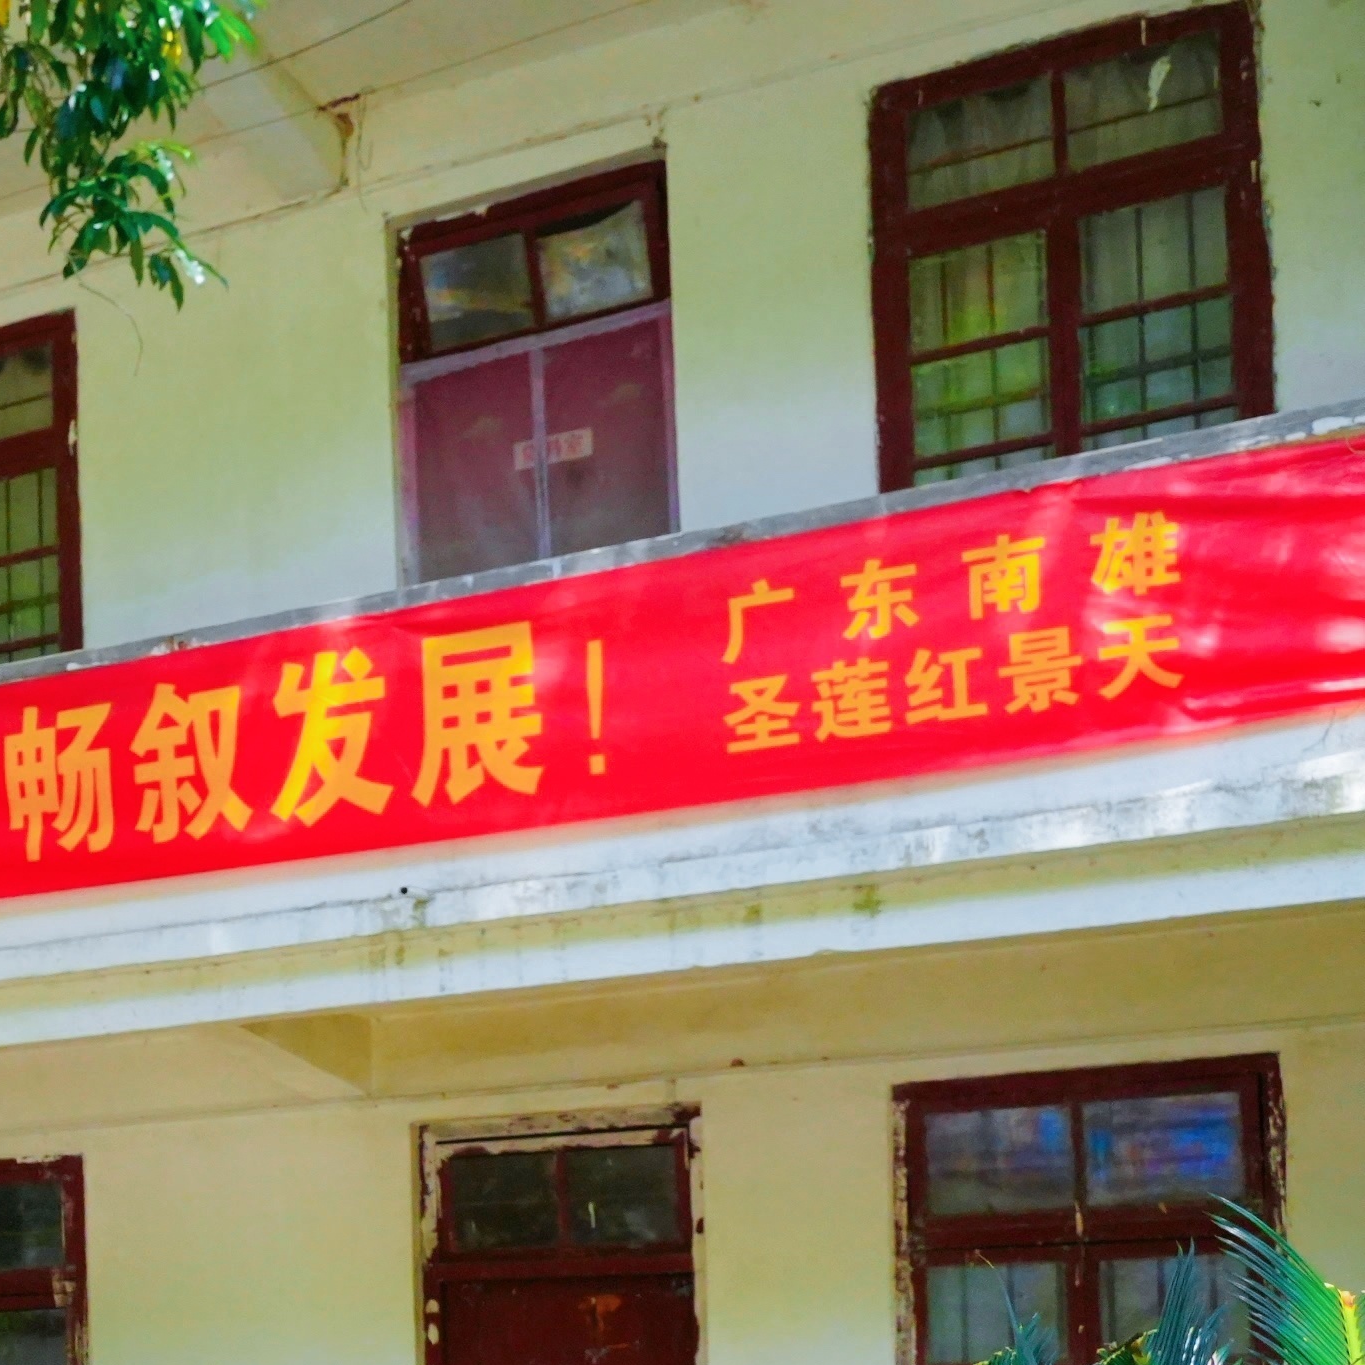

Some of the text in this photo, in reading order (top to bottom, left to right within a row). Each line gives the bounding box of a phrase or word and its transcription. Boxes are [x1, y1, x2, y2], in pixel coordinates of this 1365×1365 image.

[723, 512, 1185, 664] 广东南雄
[725, 613, 1181, 752] 圣莲红景天
